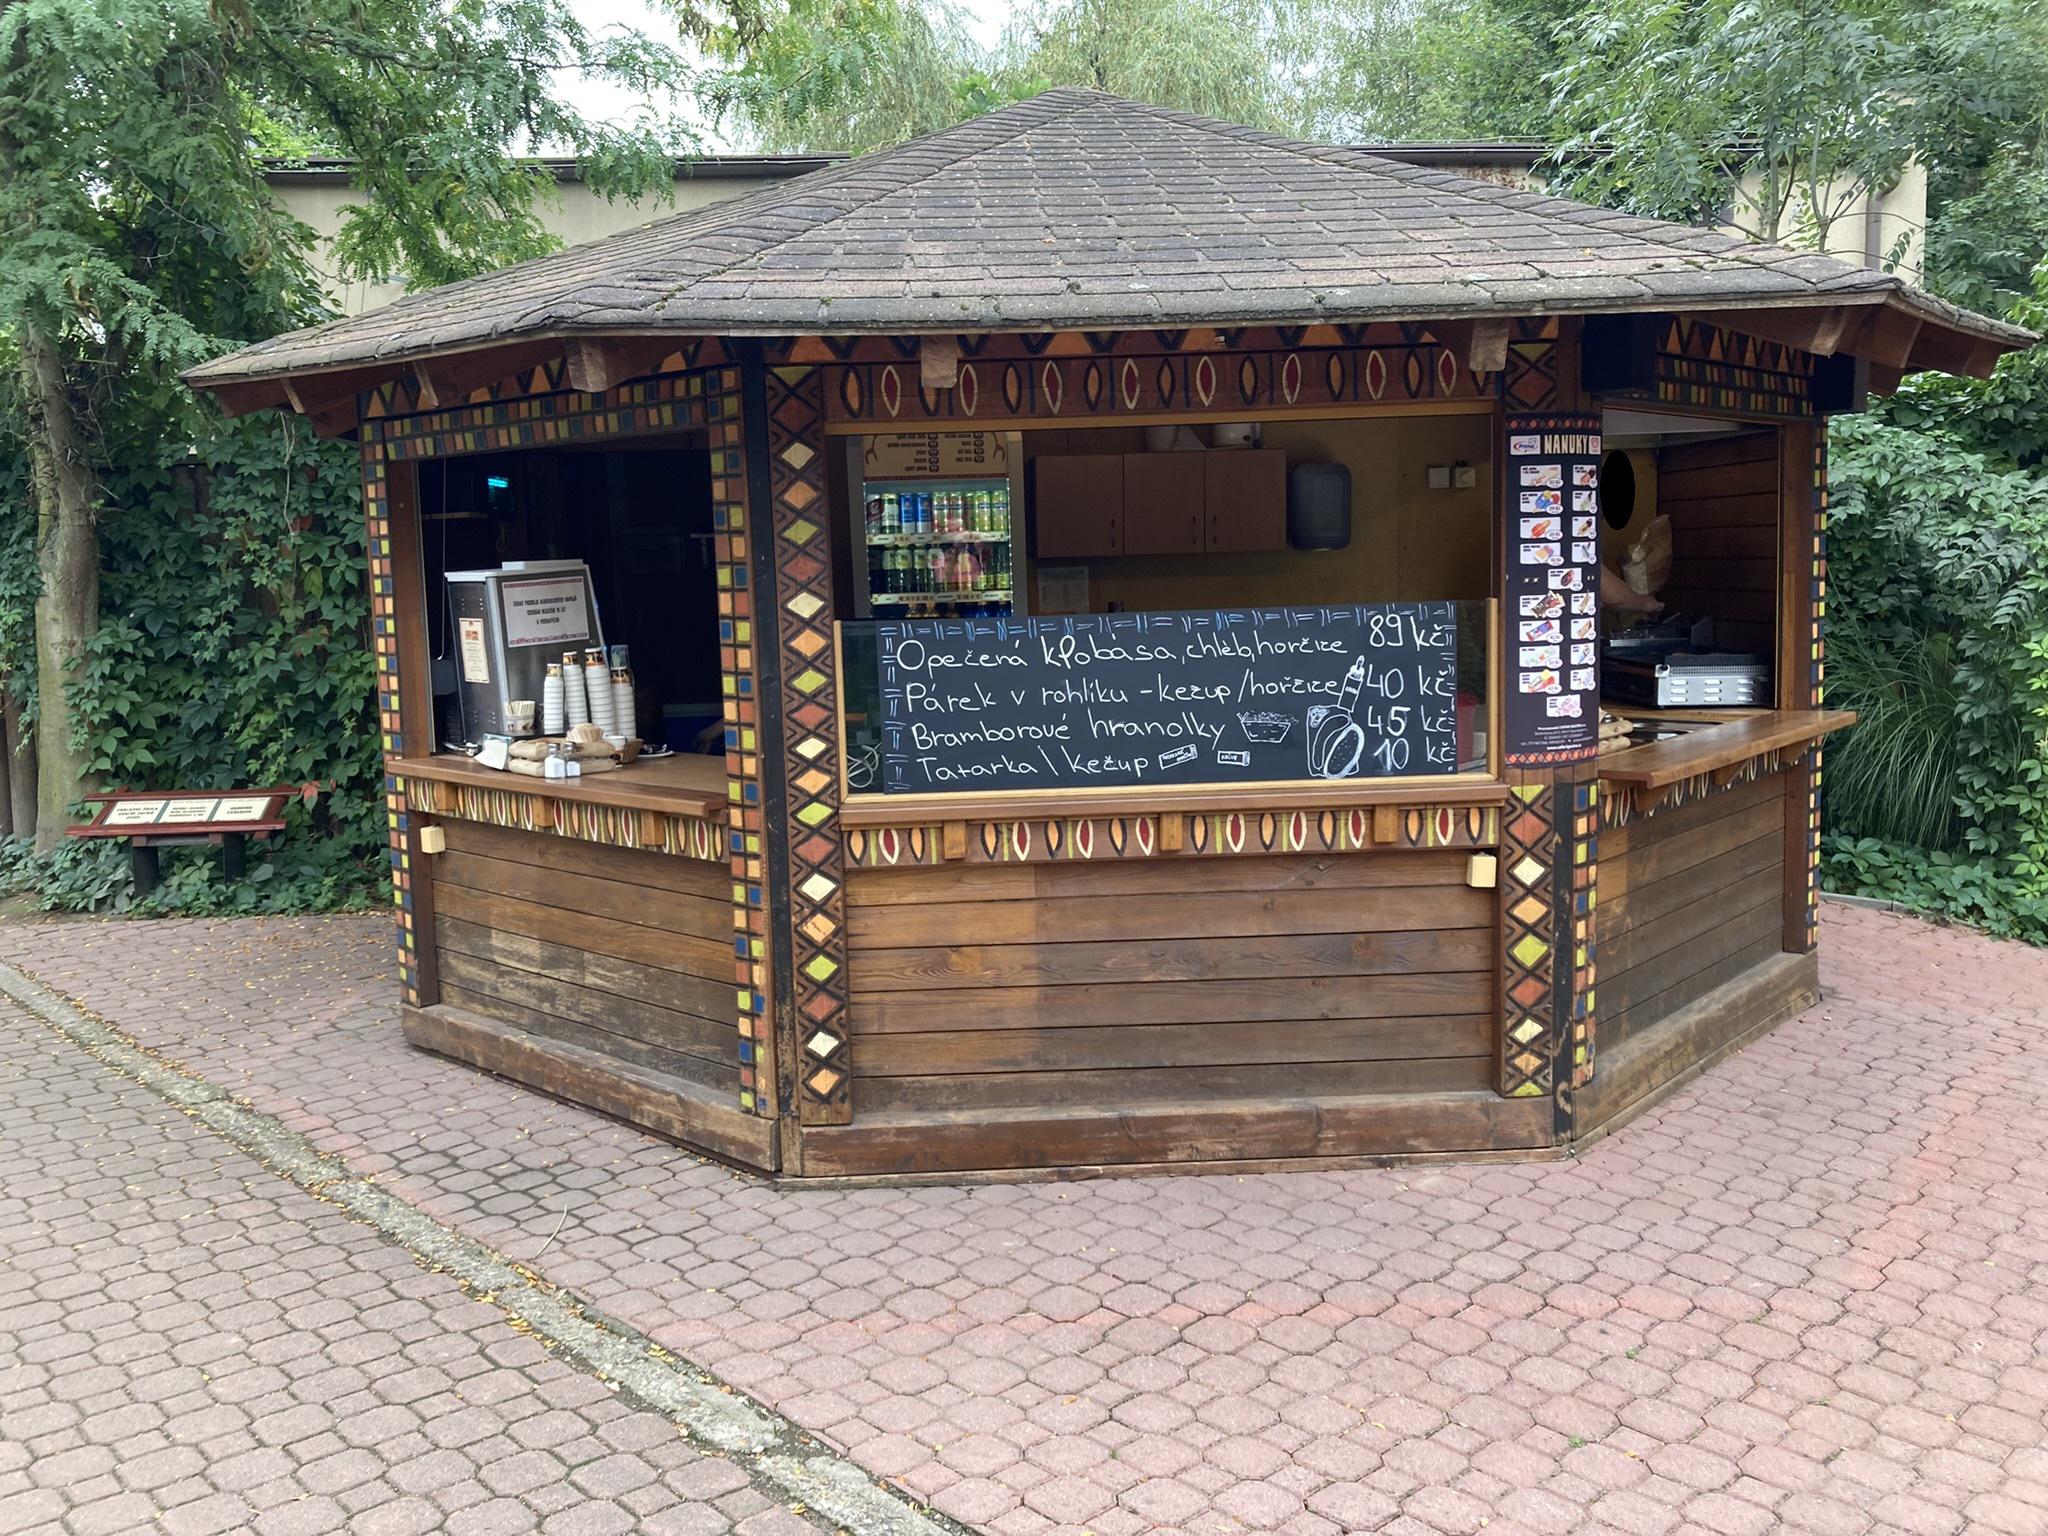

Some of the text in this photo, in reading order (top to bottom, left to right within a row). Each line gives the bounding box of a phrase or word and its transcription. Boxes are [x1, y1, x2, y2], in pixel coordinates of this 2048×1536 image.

[1544, 434, 1589, 454] NANUKY
[897, 639, 1028, 680] Opečená
[1369, 613, 1404, 648] 89
[906, 682, 997, 713] Párek
[1011, 690, 1025, 706] v
[1042, 677, 1129, 706] rohlíku
[1366, 664, 1405, 699] 40
[911, 712, 1071, 750] Bramborové
[1087, 706, 1225, 750] hranolky
[1368, 705, 1411, 736] 45
[916, 754, 1038, 782] Tatarka
[1374, 738, 1410, 771] 10
